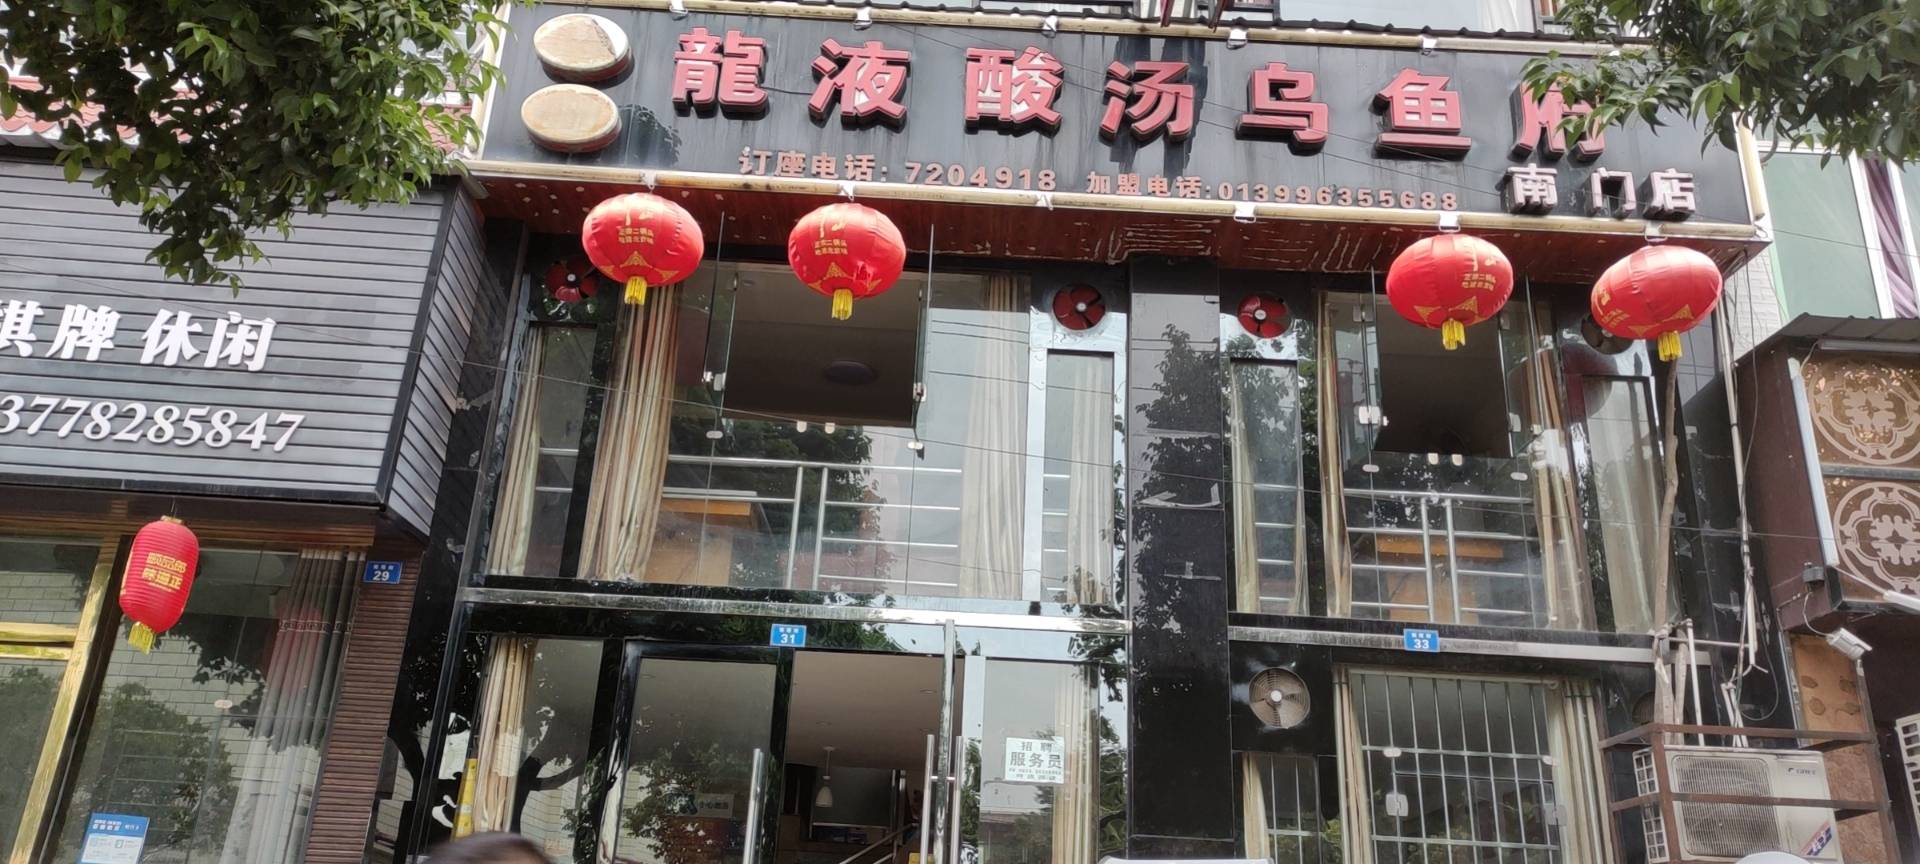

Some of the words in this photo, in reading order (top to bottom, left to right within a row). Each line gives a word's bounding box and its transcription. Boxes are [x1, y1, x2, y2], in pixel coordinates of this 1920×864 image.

[904, 160, 1057, 191] 7204918
[1507, 162, 1697, 213] 南门店
[372, 570, 390, 581] 29
[780, 633, 796, 644] 31
[1414, 639, 1430, 649] 33
[1009, 751, 1062, 769] 服务员
